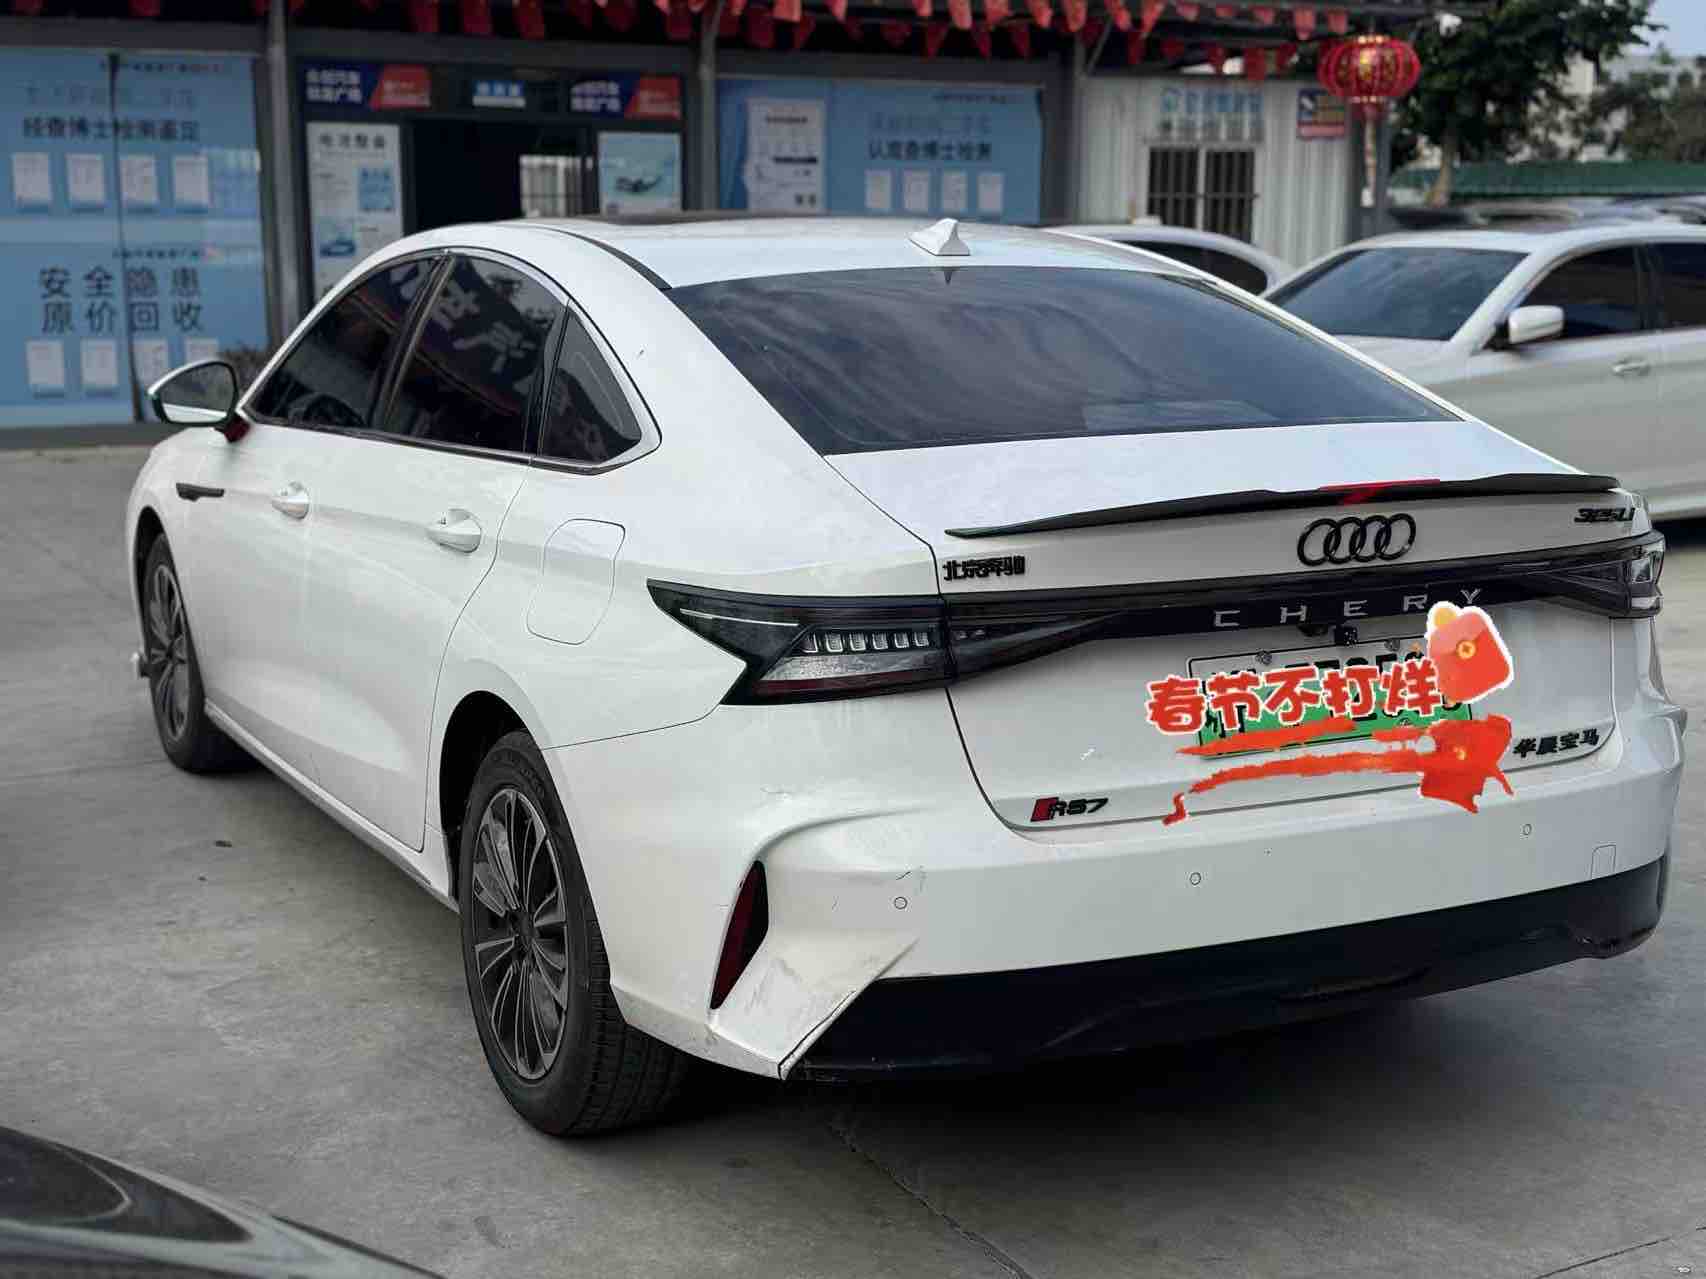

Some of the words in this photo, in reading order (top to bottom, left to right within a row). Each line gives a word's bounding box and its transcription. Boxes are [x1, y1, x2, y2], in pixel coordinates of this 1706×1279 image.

[39, 265, 203, 299] 安全隐患
[42, 301, 204, 333] 原价回收
[943, 556, 1026, 582] 北京奔驰
[1213, 588, 1482, 629] CHERY
[1512, 728, 1600, 758] 华晨宝马
